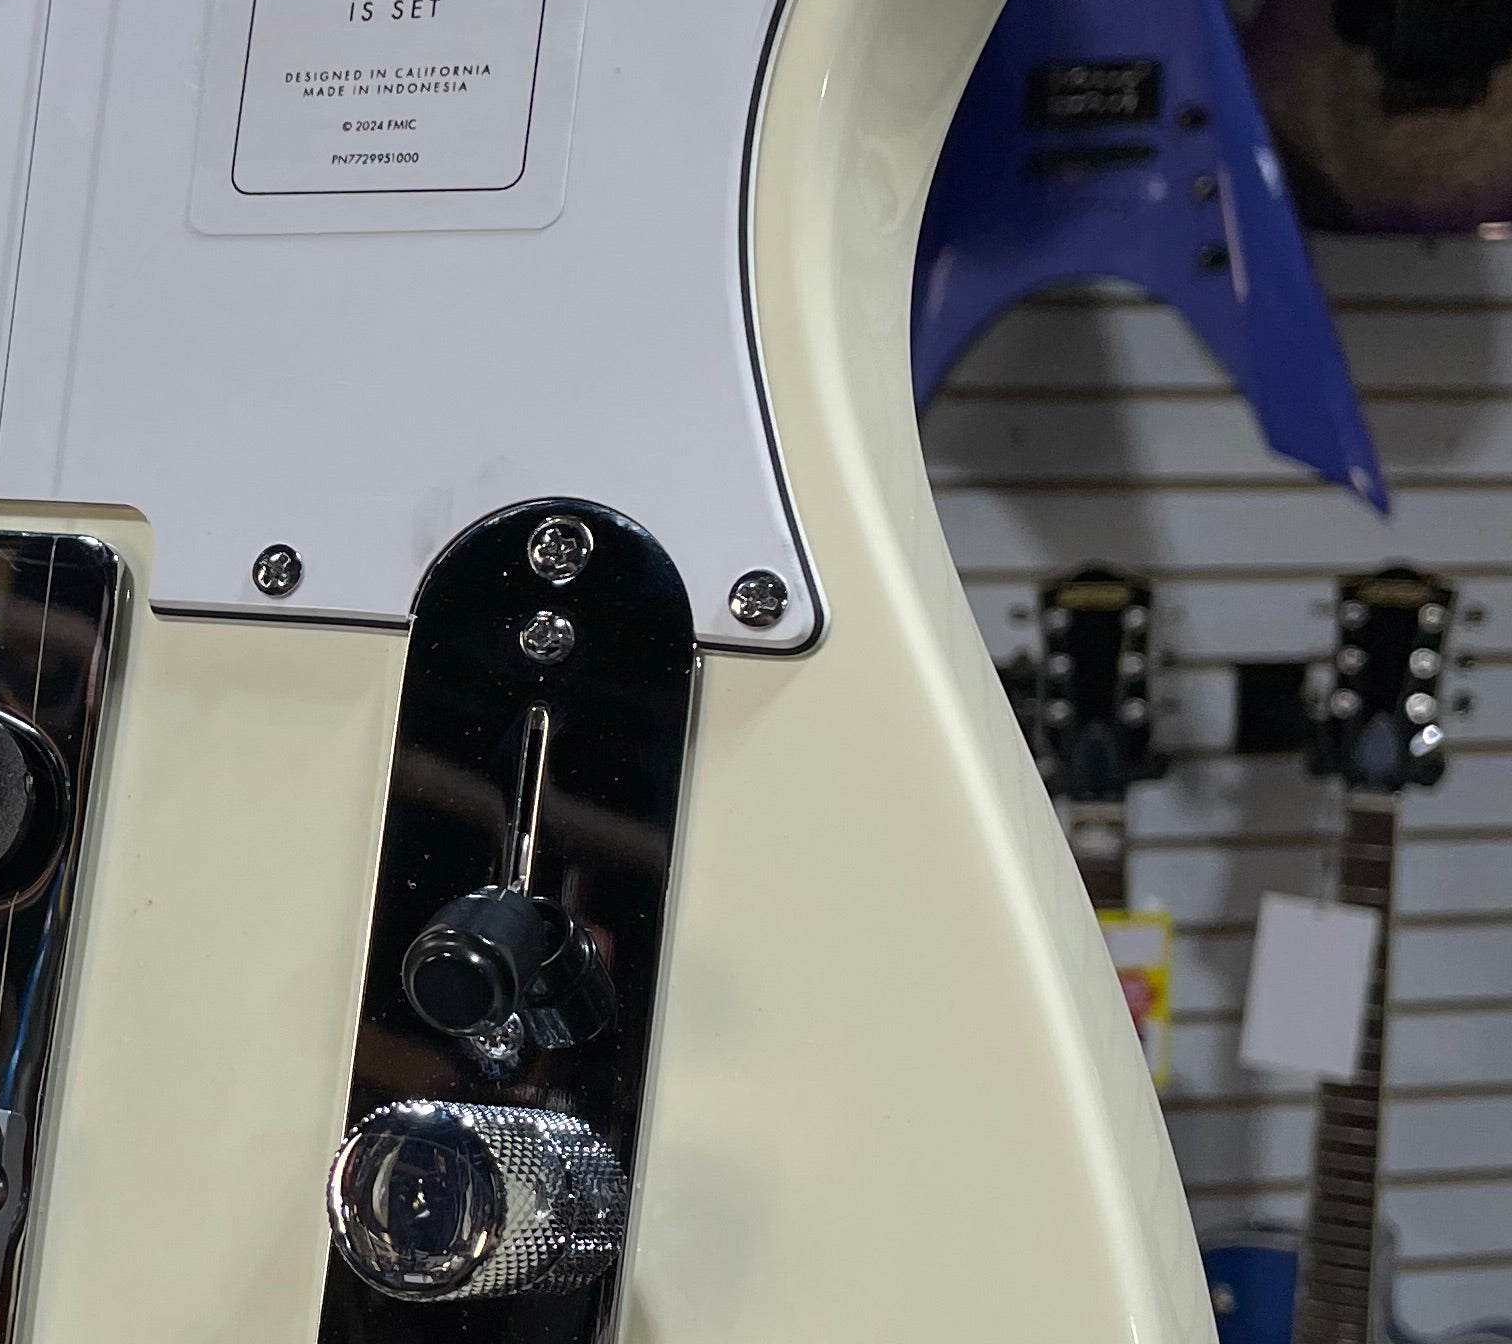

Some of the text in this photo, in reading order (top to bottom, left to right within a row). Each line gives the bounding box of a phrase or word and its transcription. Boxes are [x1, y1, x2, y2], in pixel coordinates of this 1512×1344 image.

[349, 1, 374, 22] IS
[285, 64, 491, 83] DESIGNED IN CALIFORNIA
[303, 81, 468, 97] MADE IN INDONESIA
[355, 120, 384, 131] 2024
[387, 118, 417, 130] FMIC
[331, 152, 420, 165] PN7729951000
